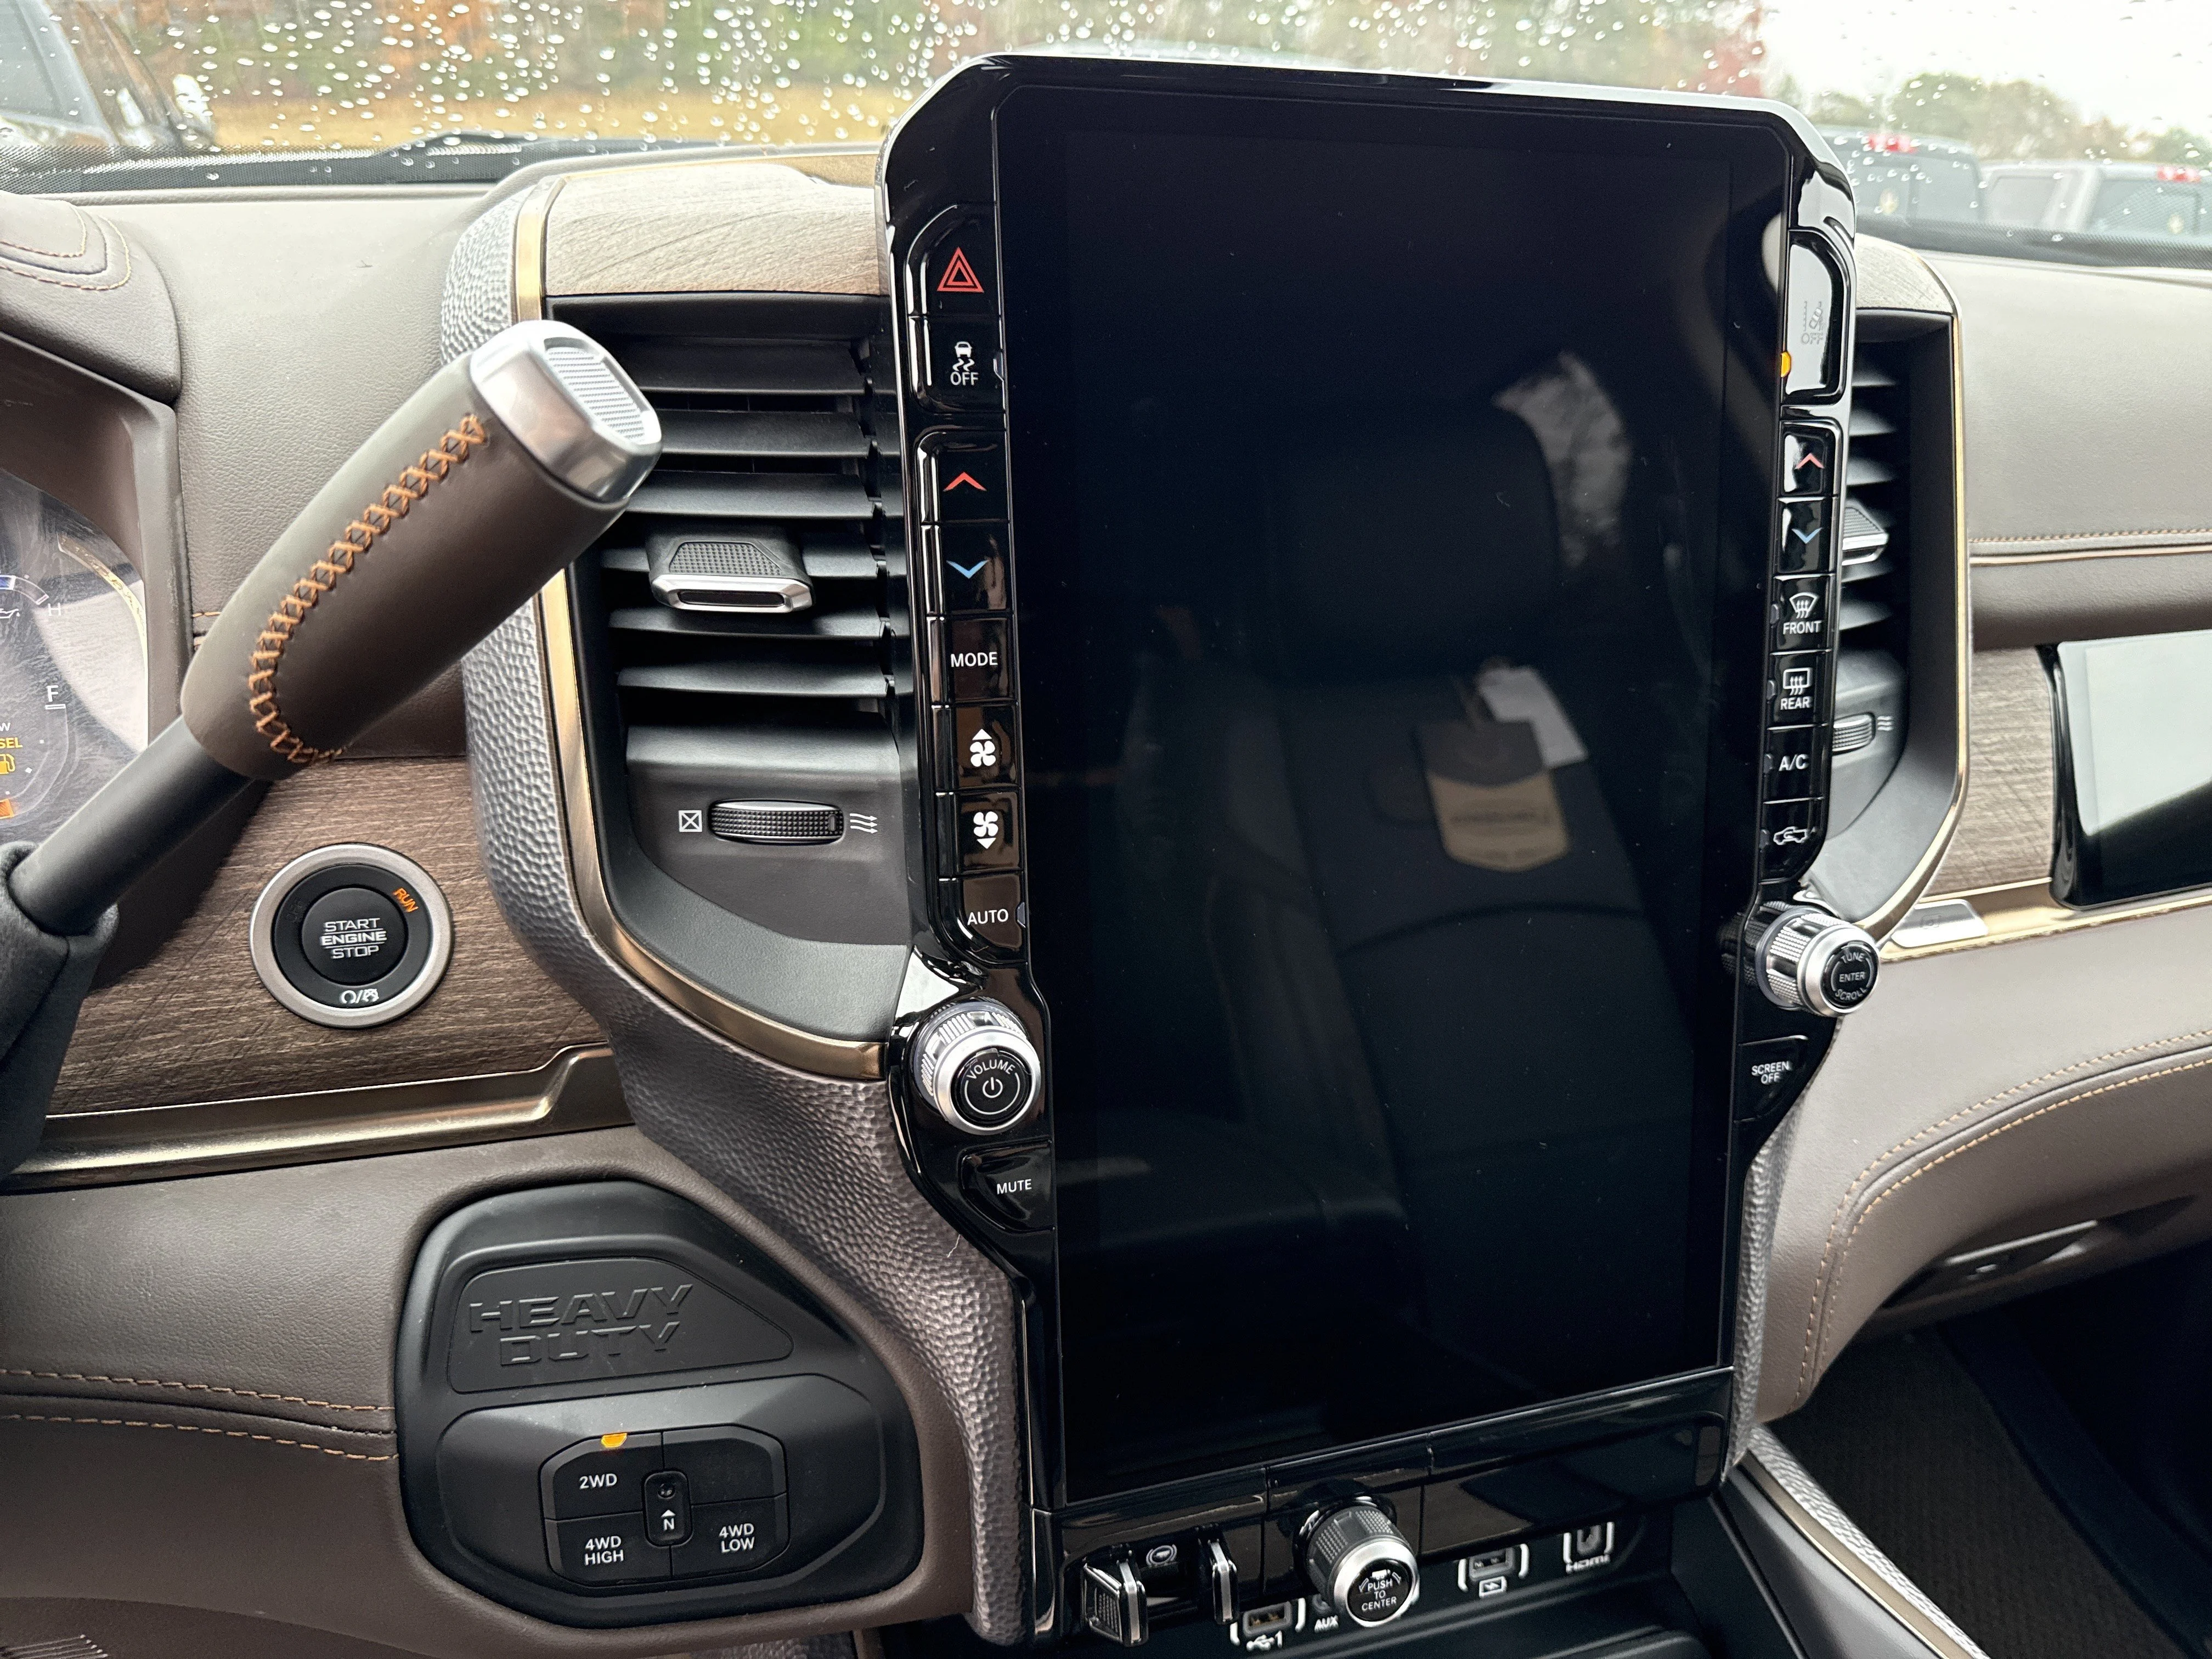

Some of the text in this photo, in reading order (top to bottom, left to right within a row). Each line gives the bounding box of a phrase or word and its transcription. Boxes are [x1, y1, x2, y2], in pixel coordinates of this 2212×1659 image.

[1801, 332, 1823, 345] OFF
[950, 371, 979, 386] OFF
[48, 603, 61, 616] H
[1782, 620, 1822, 635] FRONT
[950, 651, 998, 668] MODE
[47, 685, 59, 702] F
[1780, 696, 1811, 710] REAR
[1779, 754, 1809, 771] A/C
[393, 887, 419, 913] RUN
[323, 917, 380, 932] START
[967, 909, 1008, 926] AUTO
[321, 930, 387, 946] ENGINE
[330, 945, 379, 959] STOP
[1841, 951, 1865, 964] TUNE
[1839, 971, 1865, 983] ENTER
[1835, 987, 1867, 1001] SCROLL
[966, 1059, 1015, 1080] VOLUME
[1751, 1060, 1791, 1076] SCREEN
[1760, 1072, 1781, 1085] OFF
[996, 1179, 1032, 1194] MUTE
[469, 1284, 693, 1333] HEAVY
[500, 1321, 680, 1367] DUTY
[579, 1473, 617, 1489] 2WD
[663, 1517, 675, 1531] N
[719, 1522, 754, 1538] 4WD
[585, 1536, 622, 1551] 4WD
[720, 1536, 755, 1554] LOW
[584, 1549, 624, 1566] HIGH
[1368, 1578, 1393, 1592] PUSH
[1374, 1590, 1386, 1600] TO
[1361, 1596, 1397, 1611] CENTER
[1314, 1615, 1339, 1633] AUX
